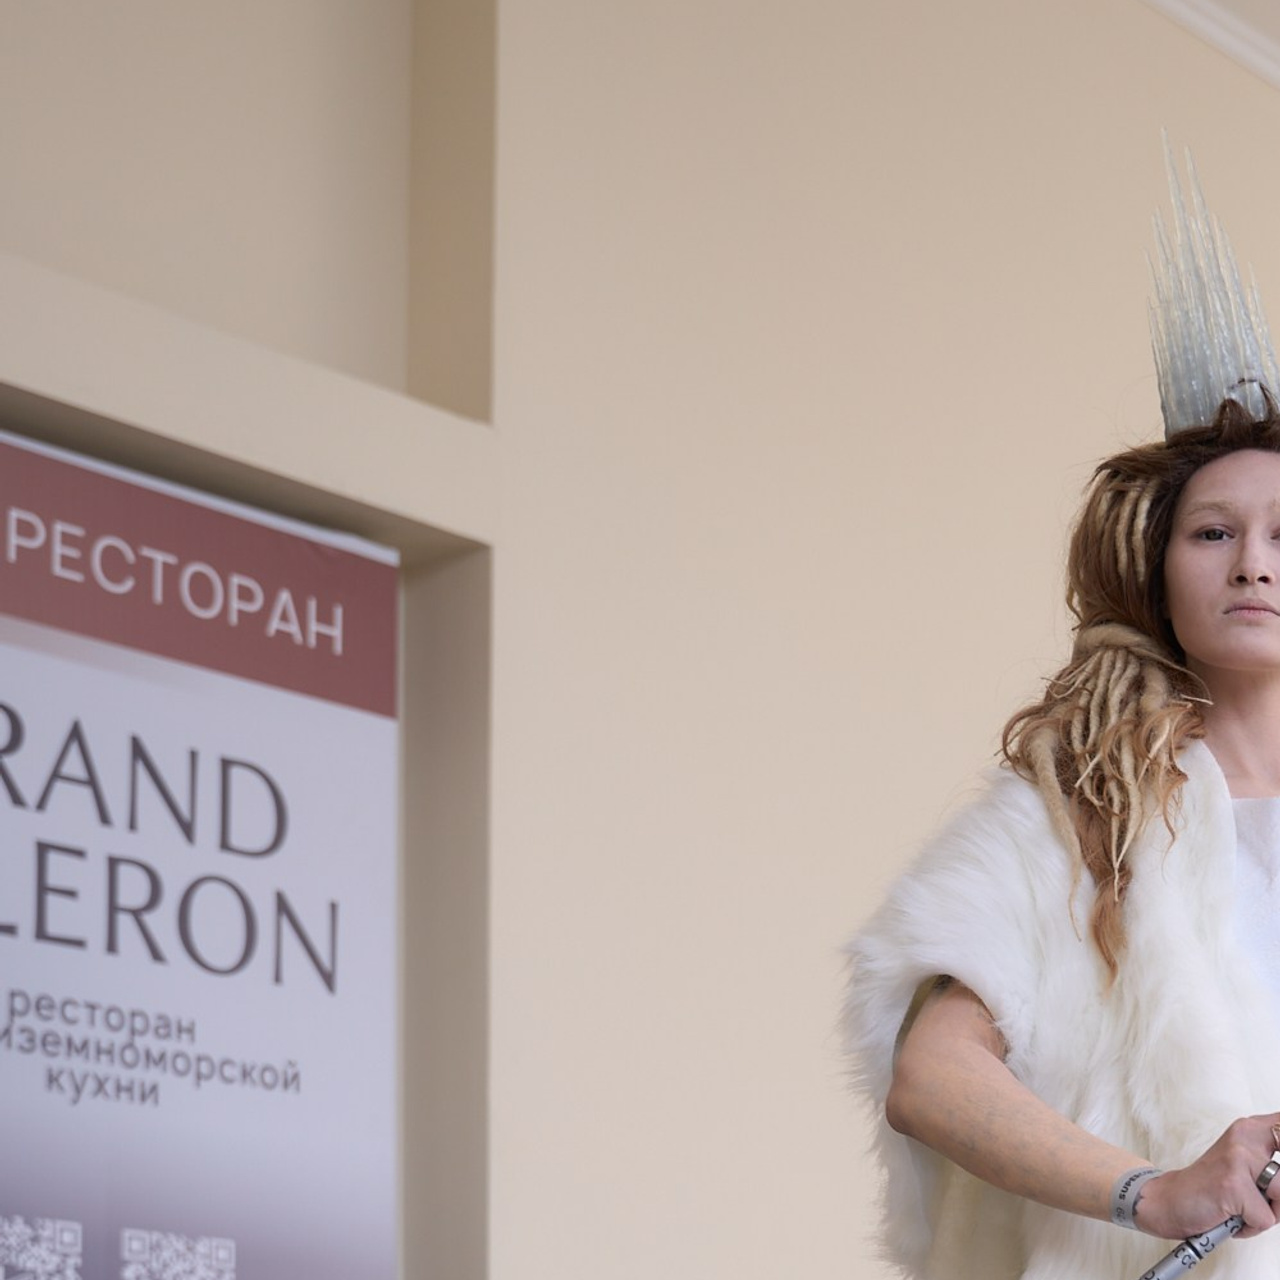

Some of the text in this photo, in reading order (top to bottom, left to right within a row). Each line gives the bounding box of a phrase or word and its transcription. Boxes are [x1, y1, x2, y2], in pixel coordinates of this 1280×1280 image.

[6, 506, 345, 656] РЕСТОРАН
[8, 988, 196, 1044] ресторан
[45, 1067, 160, 1106] кухни
